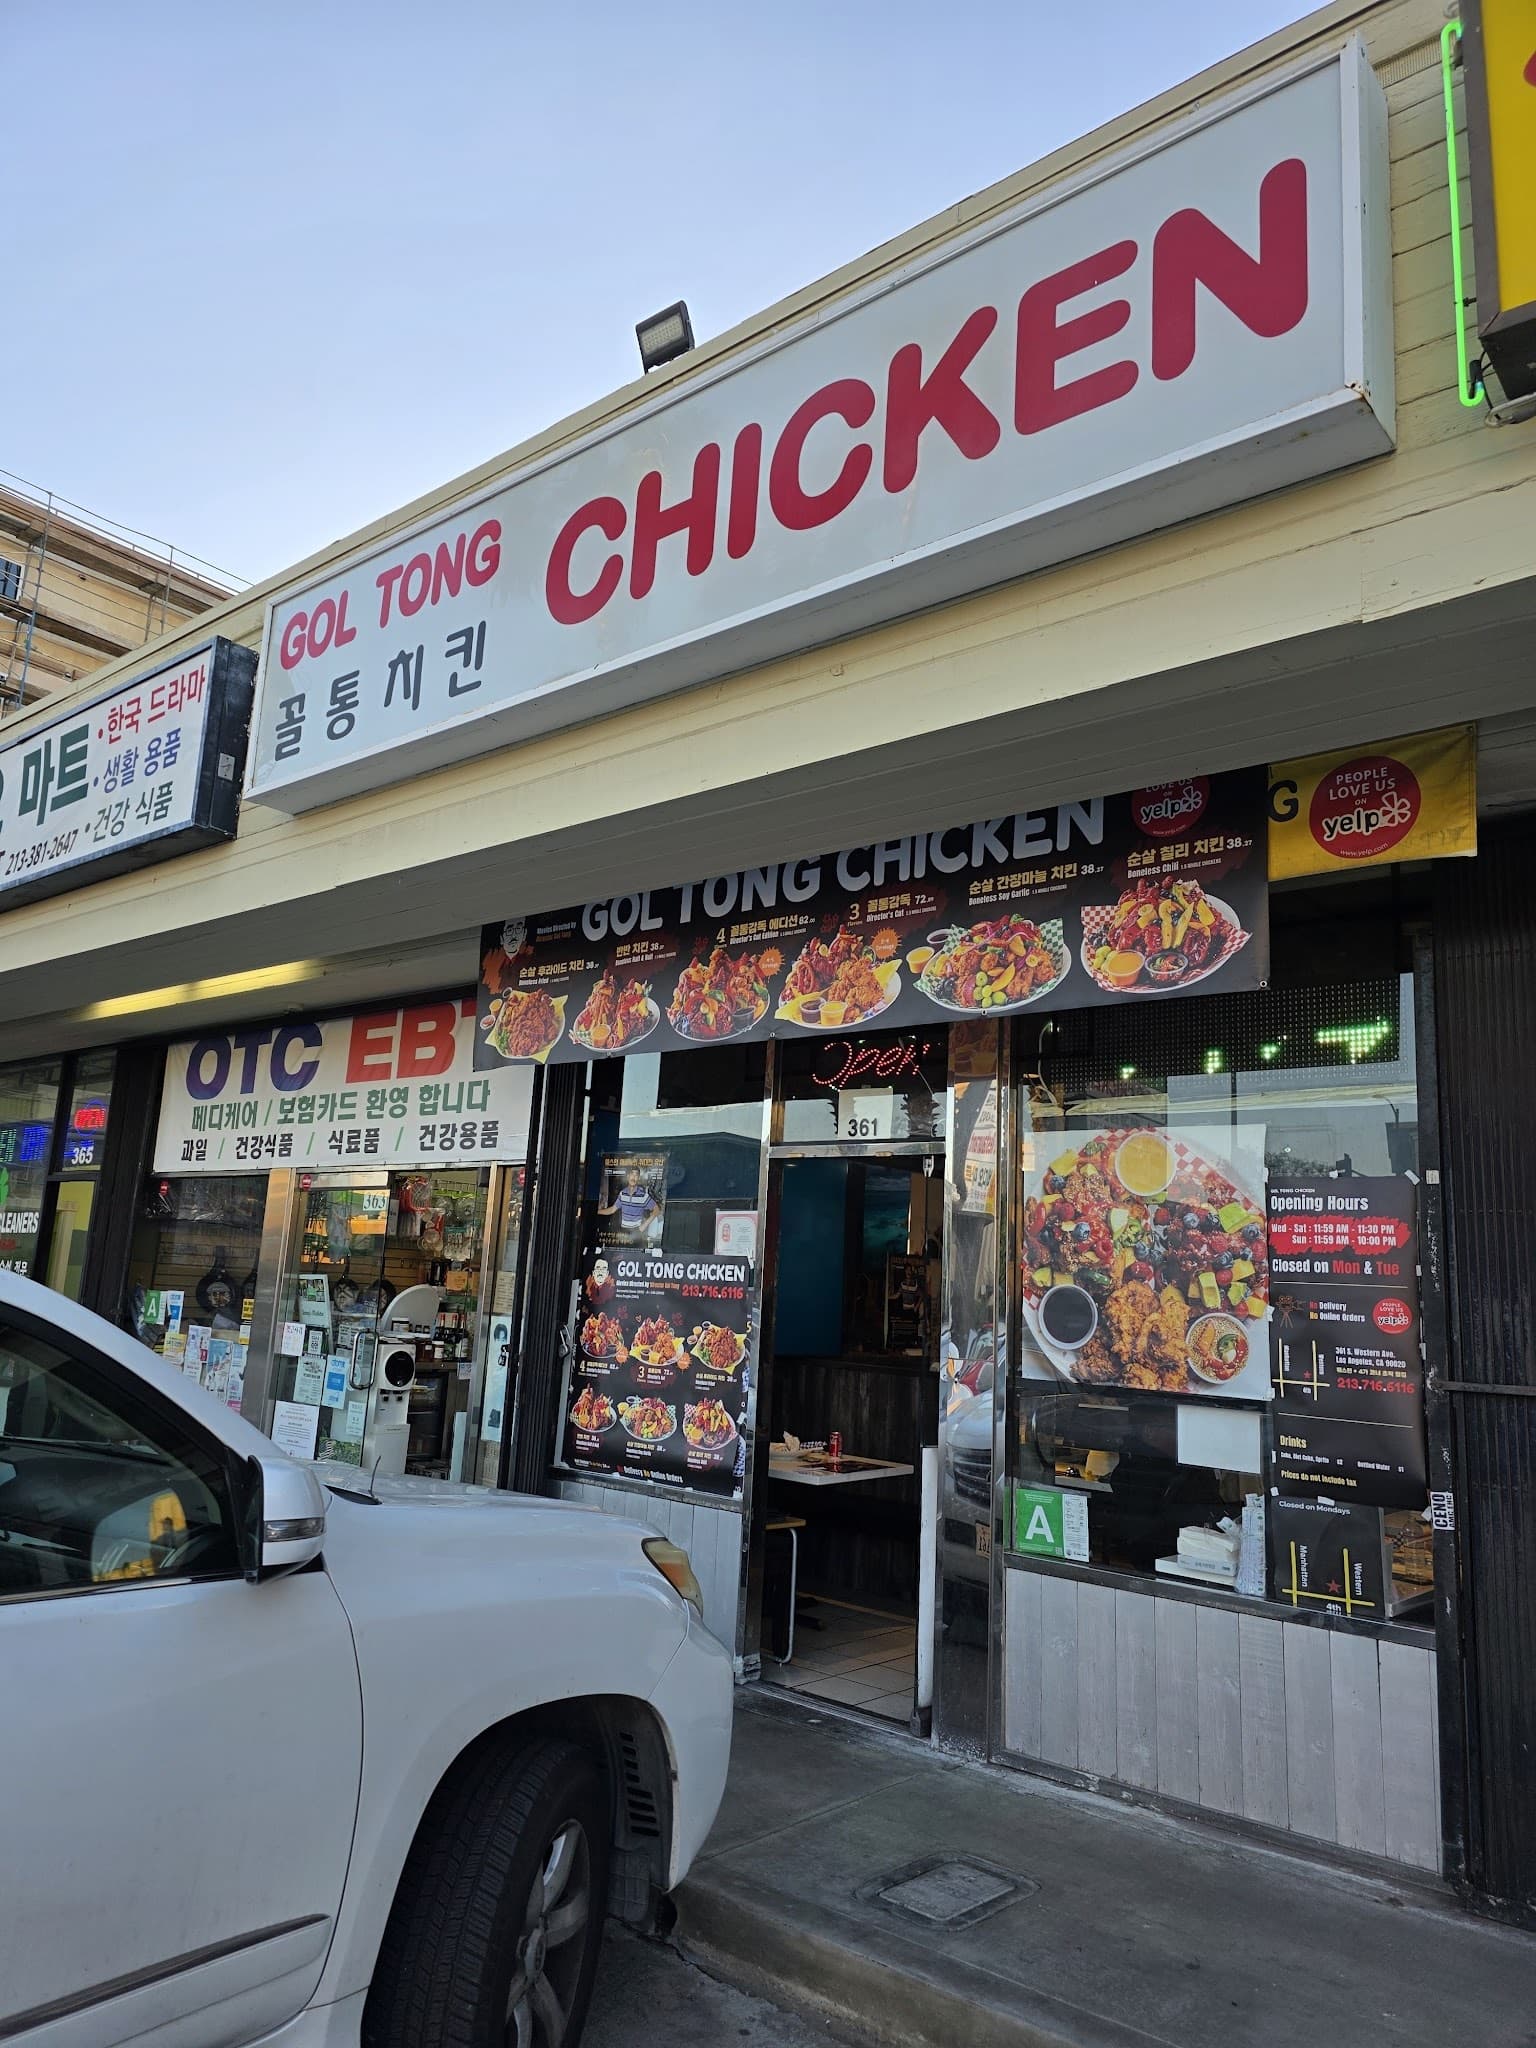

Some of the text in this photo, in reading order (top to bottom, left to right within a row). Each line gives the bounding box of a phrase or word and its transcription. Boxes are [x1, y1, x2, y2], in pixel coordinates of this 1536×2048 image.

[280, 158, 1307, 671] GOL TONG CHICKEN
[108, 664, 206, 745] 한국 드라마
[103, 728, 182, 794] 생활 용품
[19, 723, 90, 826] 마트
[1336, 766, 1389, 785] PEOPLE
[1329, 777, 1396, 801] LOVE US
[93, 780, 174, 843] 건강 식품
[1142, 798, 1181, 824] yelp
[1355, 798, 1367, 806] ON
[1323, 807, 1380, 840] yelp
[5, 828, 79, 876] 213-381-2647
[1127, 849, 1156, 868] 순살
[1160, 842, 1190, 861] 칠리
[1194, 835, 1225, 855] 치킨
[1340, 842, 1389, 857] www.yelp.com
[582, 797, 1104, 942] GOL TONG CHICKEN
[969, 878, 994, 896] 순살
[997, 869, 1048, 891] 간장마늘
[1051, 862, 1078, 880] 치킨
[1127, 865, 1161, 879] Boneless
[999, 892, 1010, 901] Soy
[849, 903, 860, 920] 3
[716, 928, 726, 943] 4
[186, 1002, 477, 1100] OTC EB
[192, 1100, 258, 1132] 메디케어
[277, 1097, 358, 1125] 보험카드
[366, 1086, 411, 1121] 환영
[419, 1079, 491, 1115] 합니다
[848, 1118, 878, 1137] 361
[182, 1139, 208, 1162] 과일
[236, 1133, 294, 1160] 건강식품
[328, 1128, 381, 1154] 식료품
[419, 1120, 500, 1153] 건강용품
[72, 1145, 94, 1165] 365
[1270, 1194, 1369, 1212] Opening Hours
[1271, 1223, 1395, 1235] Wed Sat 11:59 AM 11:30 PM
[1292, 1235, 1396, 1247] Sun 11:59 AM 10:00 PM
[617, 1260, 745, 1282] GOL TONG CHICKEN
[1272, 1259, 1400, 1276] Closed on Mon & Tue
[682, 1284, 743, 1299] 213.716.6116
[147, 1297, 157, 1316] A
[1319, 1301, 1347, 1312] Delivery
[1309, 1312, 1365, 1322] No Online Orders
[1354, 1348, 1380, 1357] Western
[638, 1366, 645, 1378] 3
[1337, 1377, 1415, 1394] 213.716.6116
[1280, 1435, 1307, 1449] Drinks
[1281, 1470, 1357, 1487] Prices do not include tax
[1279, 1500, 1305, 1510] Closed
[1316, 1504, 1351, 1515] Mondays
[1025, 1504, 1054, 1543] A
[1300, 1545, 1308, 1588] Manhattan
[1354, 1562, 1363, 1596] Western
[1326, 1603, 1342, 1612] 4th
